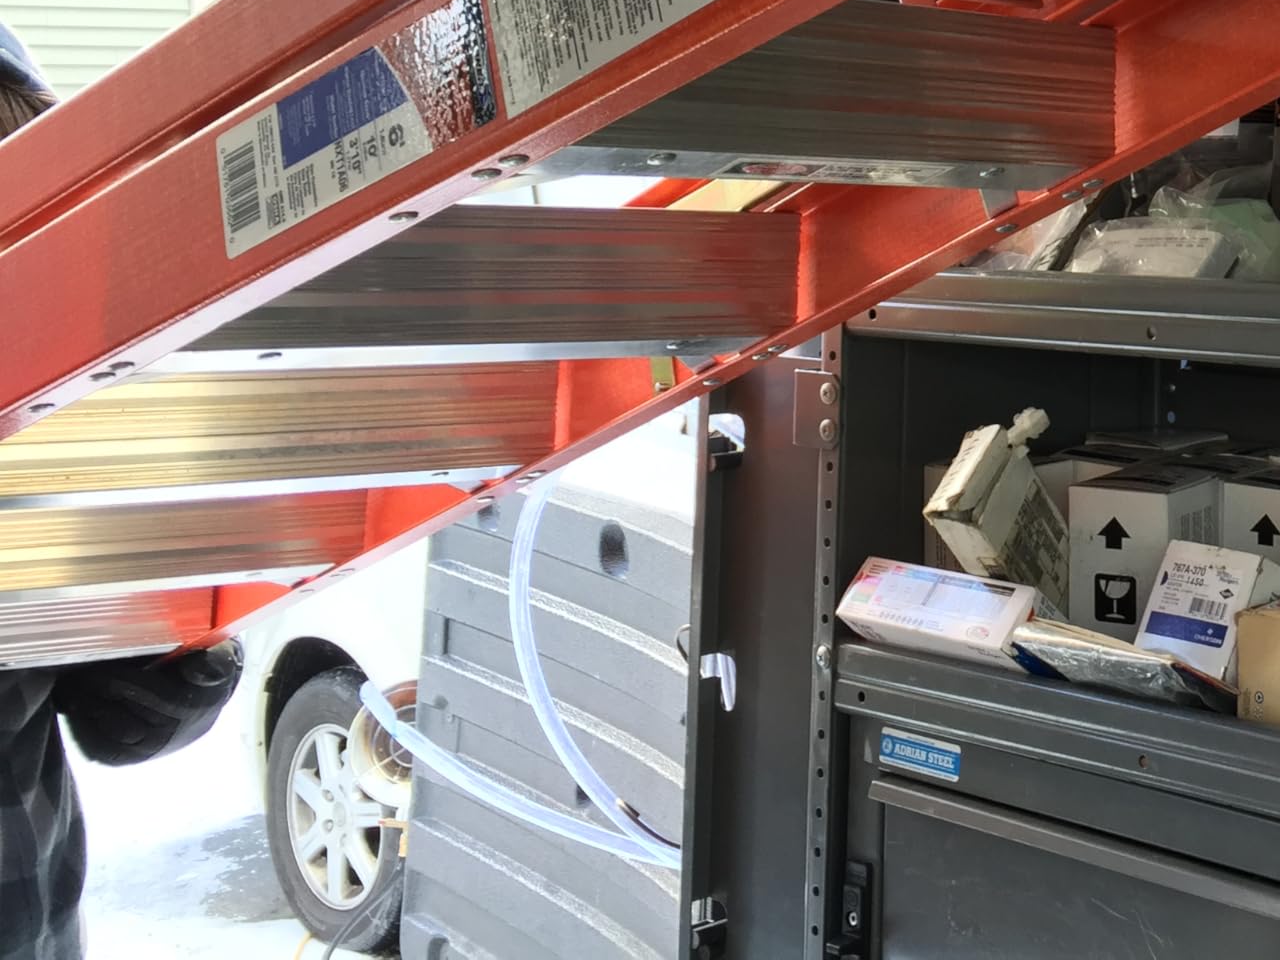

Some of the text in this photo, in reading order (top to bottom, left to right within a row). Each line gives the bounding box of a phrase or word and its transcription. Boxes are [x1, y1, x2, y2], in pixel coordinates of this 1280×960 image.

[1172, 562, 1207, 576] 767A-370
[894, 743, 954, 768] ADRIAN STEEL
